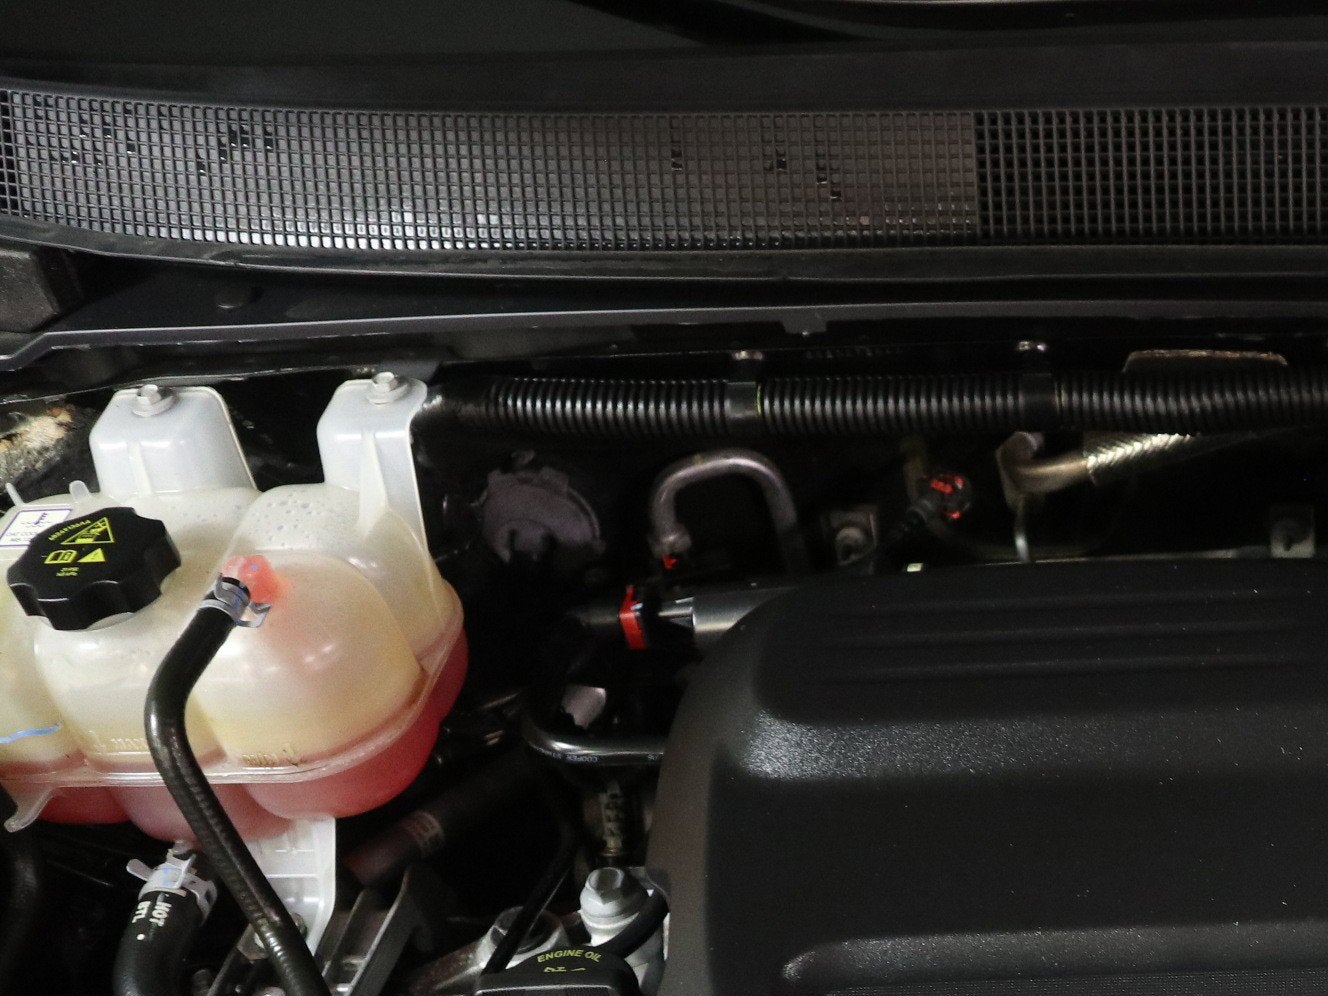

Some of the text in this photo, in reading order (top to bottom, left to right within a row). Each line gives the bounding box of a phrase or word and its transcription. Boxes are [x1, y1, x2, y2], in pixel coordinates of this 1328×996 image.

[149, 901, 172, 927] HOT
[537, 949, 603, 963] ENGINE OIL
